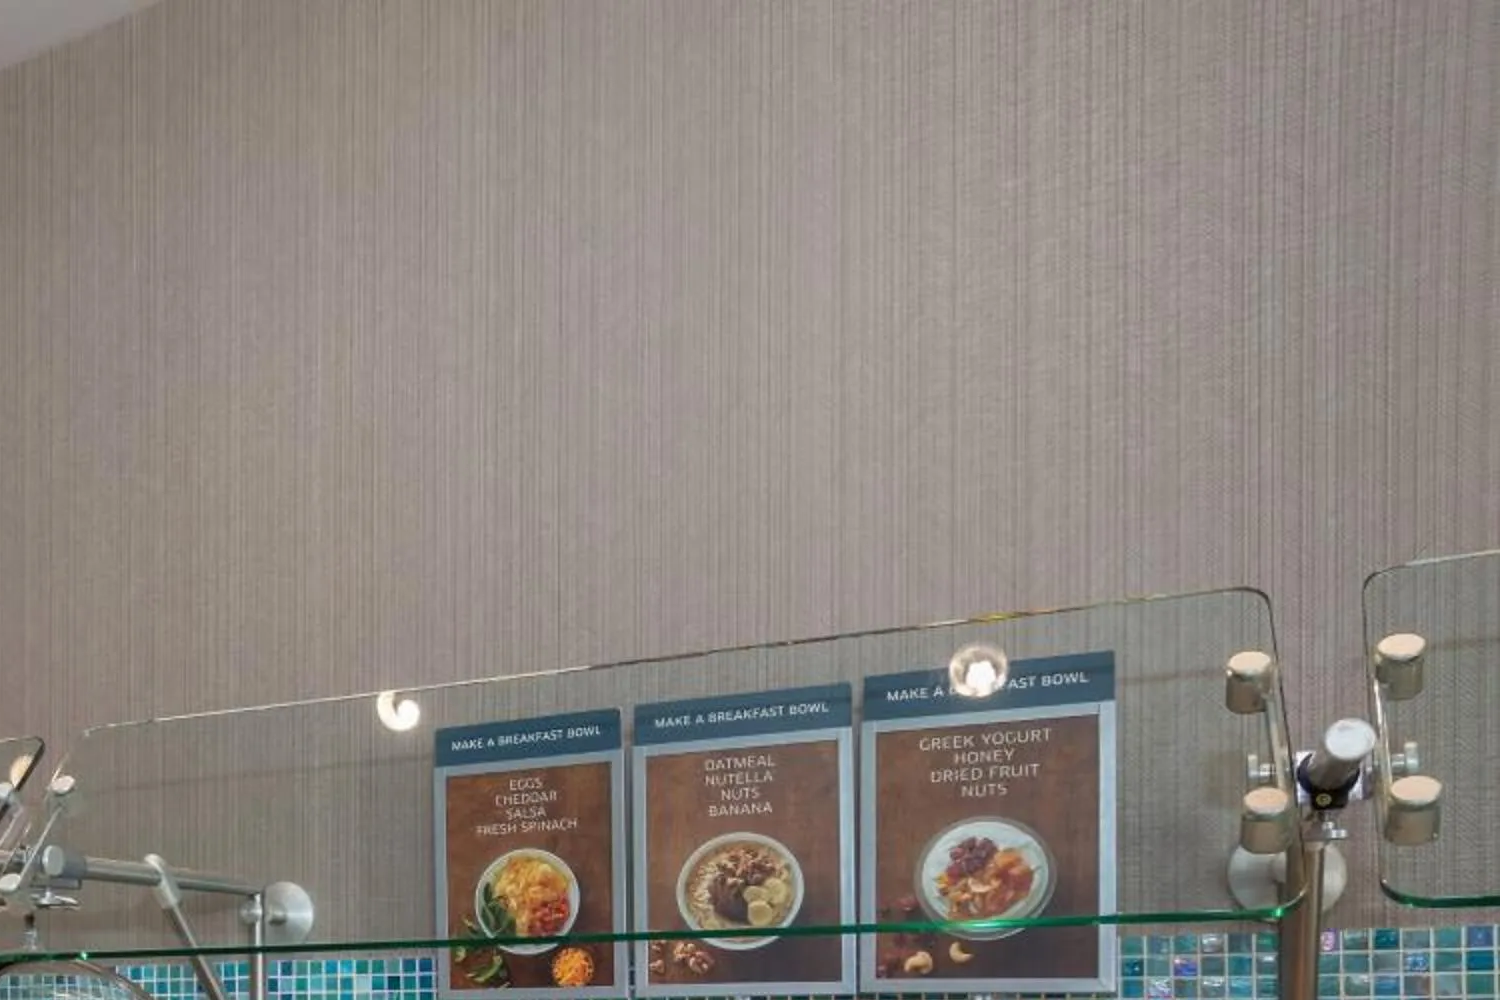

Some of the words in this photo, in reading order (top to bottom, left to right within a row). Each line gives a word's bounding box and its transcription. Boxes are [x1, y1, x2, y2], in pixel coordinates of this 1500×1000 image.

[1041, 671, 1090, 687] BOWL
[887, 686, 928, 701] MAKE
[933, 685, 944, 697] A
[654, 713, 691, 728] MAKE
[695, 713, 705, 725] A
[707, 705, 785, 723] BREAKFAST
[789, 701, 829, 716] BOWL
[451, 736, 483, 751] MAKE
[487, 737, 495, 748] A
[497, 729, 564, 747] BREAKFAST
[567, 724, 601, 739] BOWL
[919, 735, 976, 751] GREEK
[981, 728, 1052, 746] YOGURT
[704, 755, 776, 771] OATMEAL
[954, 749, 1016, 765] HONEY
[704, 771, 774, 787] NUTELLA
[930, 766, 984, 784] DRIED
[989, 763, 1041, 779] FRUIT
[509, 777, 544, 791] EGGS
[961, 784, 1008, 798] NUTS
[495, 791, 557, 807] CHEDDAR
[721, 787, 761, 801] NUTS
[505, 806, 547, 821] SALSA
[708, 802, 773, 817] BANANA
[476, 823, 517, 836] FRESH
[521, 818, 578, 833] SPINACH
